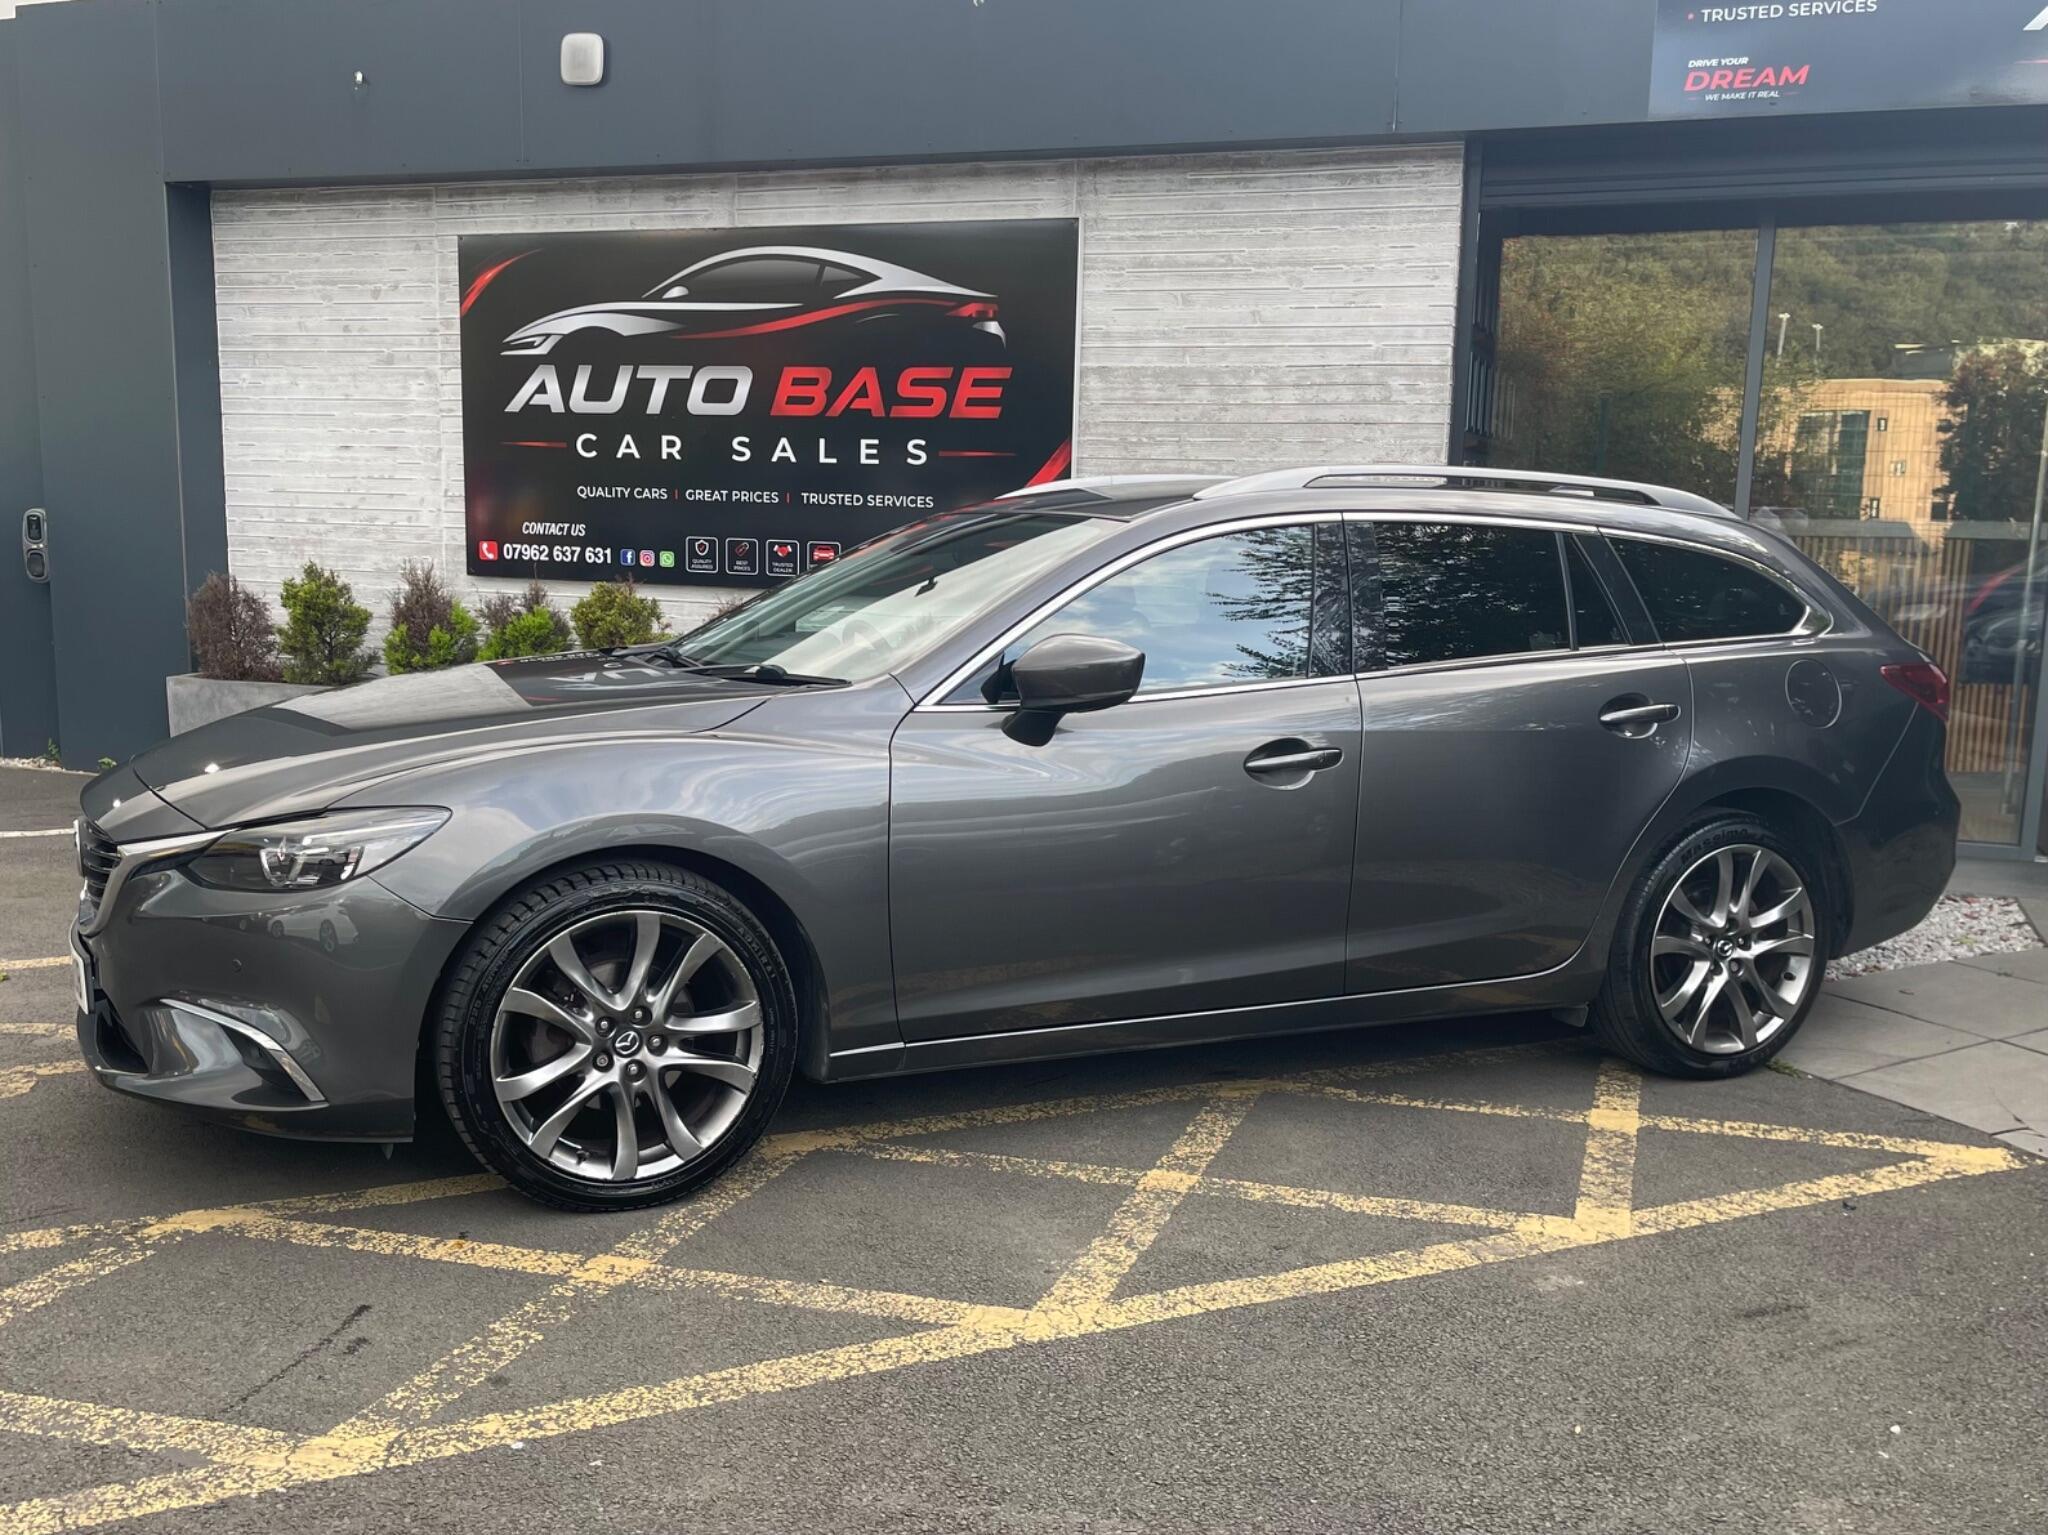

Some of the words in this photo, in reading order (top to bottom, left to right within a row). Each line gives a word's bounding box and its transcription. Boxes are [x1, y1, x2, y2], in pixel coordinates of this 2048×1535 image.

[1701, 4, 1783, 22] TRUSTED
[1788, 0, 1877, 17] SERVICES
[1688, 58, 1719, 68] DRIVE
[1720, 57, 1749, 66] YOUR
[1683, 64, 1811, 91] DREAM
[1705, 93, 1720, 101] WE
[1721, 92, 1747, 100] MAKE
[1748, 91, 1757, 99] IT
[1757, 90, 1780, 98] REAL
[504, 364, 753, 416] AUTO
[770, 366, 1013, 419] BASE
[575, 433, 682, 461] CAR
[731, 436, 928, 465] SALES
[576, 486, 631, 499] QUALITY
[633, 488, 668, 500] CARS
[685, 489, 728, 501] GREAT
[732, 491, 779, 504] PRICES
[801, 492, 863, 506] TRUSTED
[867, 494, 934, 508] SERVICES
[522, 522, 570, 536] CONTACT
[570, 523, 586, 537] US
[503, 543, 549, 561] 07962
[553, 545, 582, 562] 637
[584, 547, 612, 564] 631
